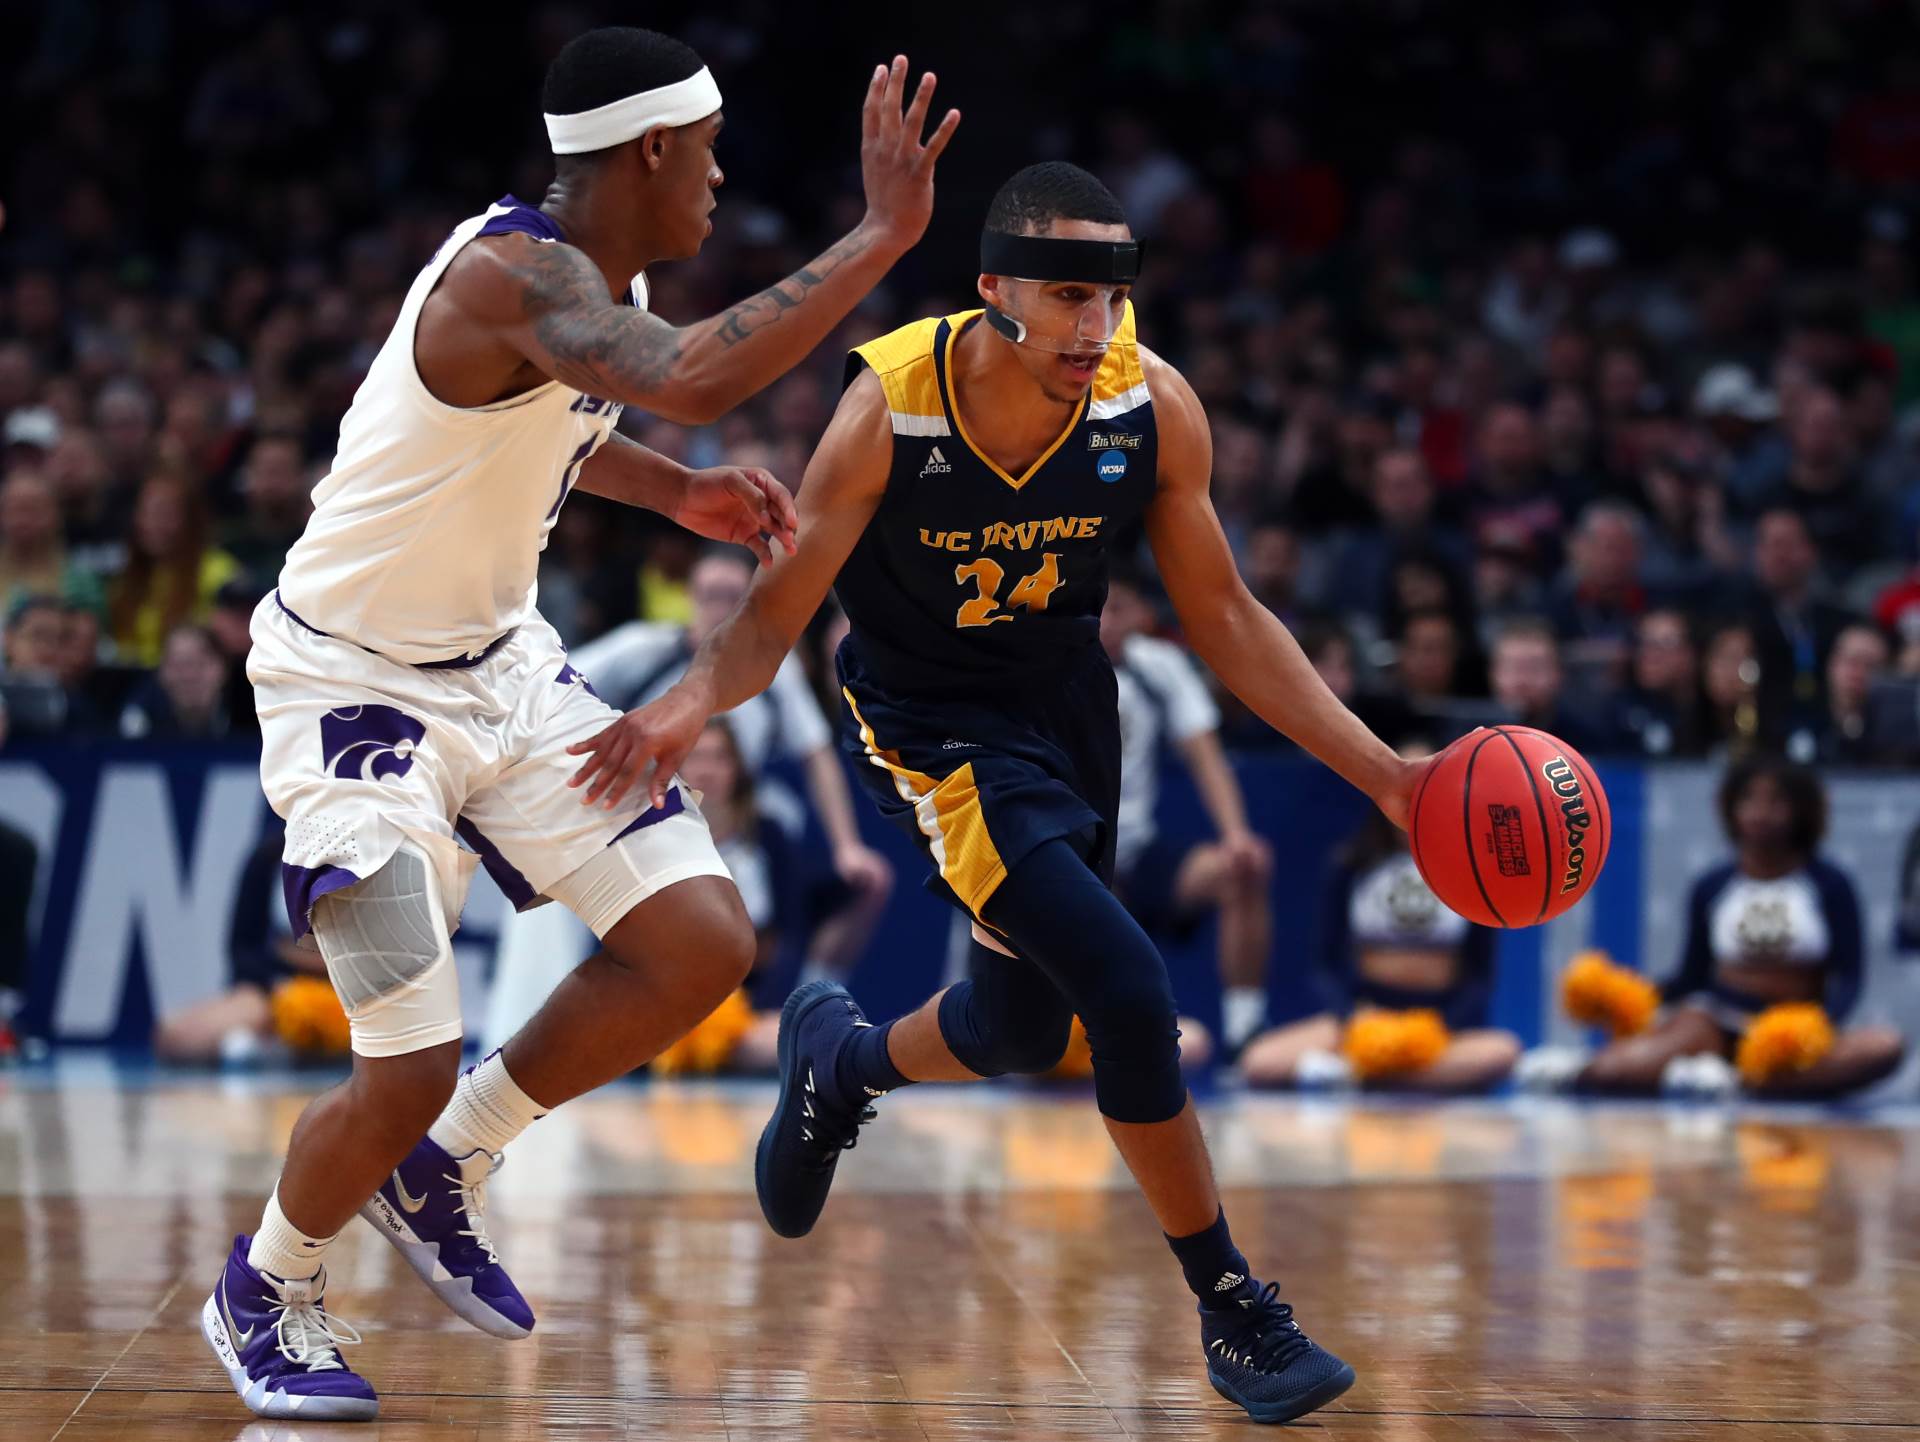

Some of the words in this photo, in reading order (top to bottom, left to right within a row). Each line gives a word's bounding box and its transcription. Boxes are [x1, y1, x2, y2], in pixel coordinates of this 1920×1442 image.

[1101, 465, 1125, 474] NCAA
[919, 528, 972, 552] UC
[981, 516, 1104, 552] IRVINE
[954, 552, 1067, 629] 24
[1542, 756, 1592, 895] Wilson
